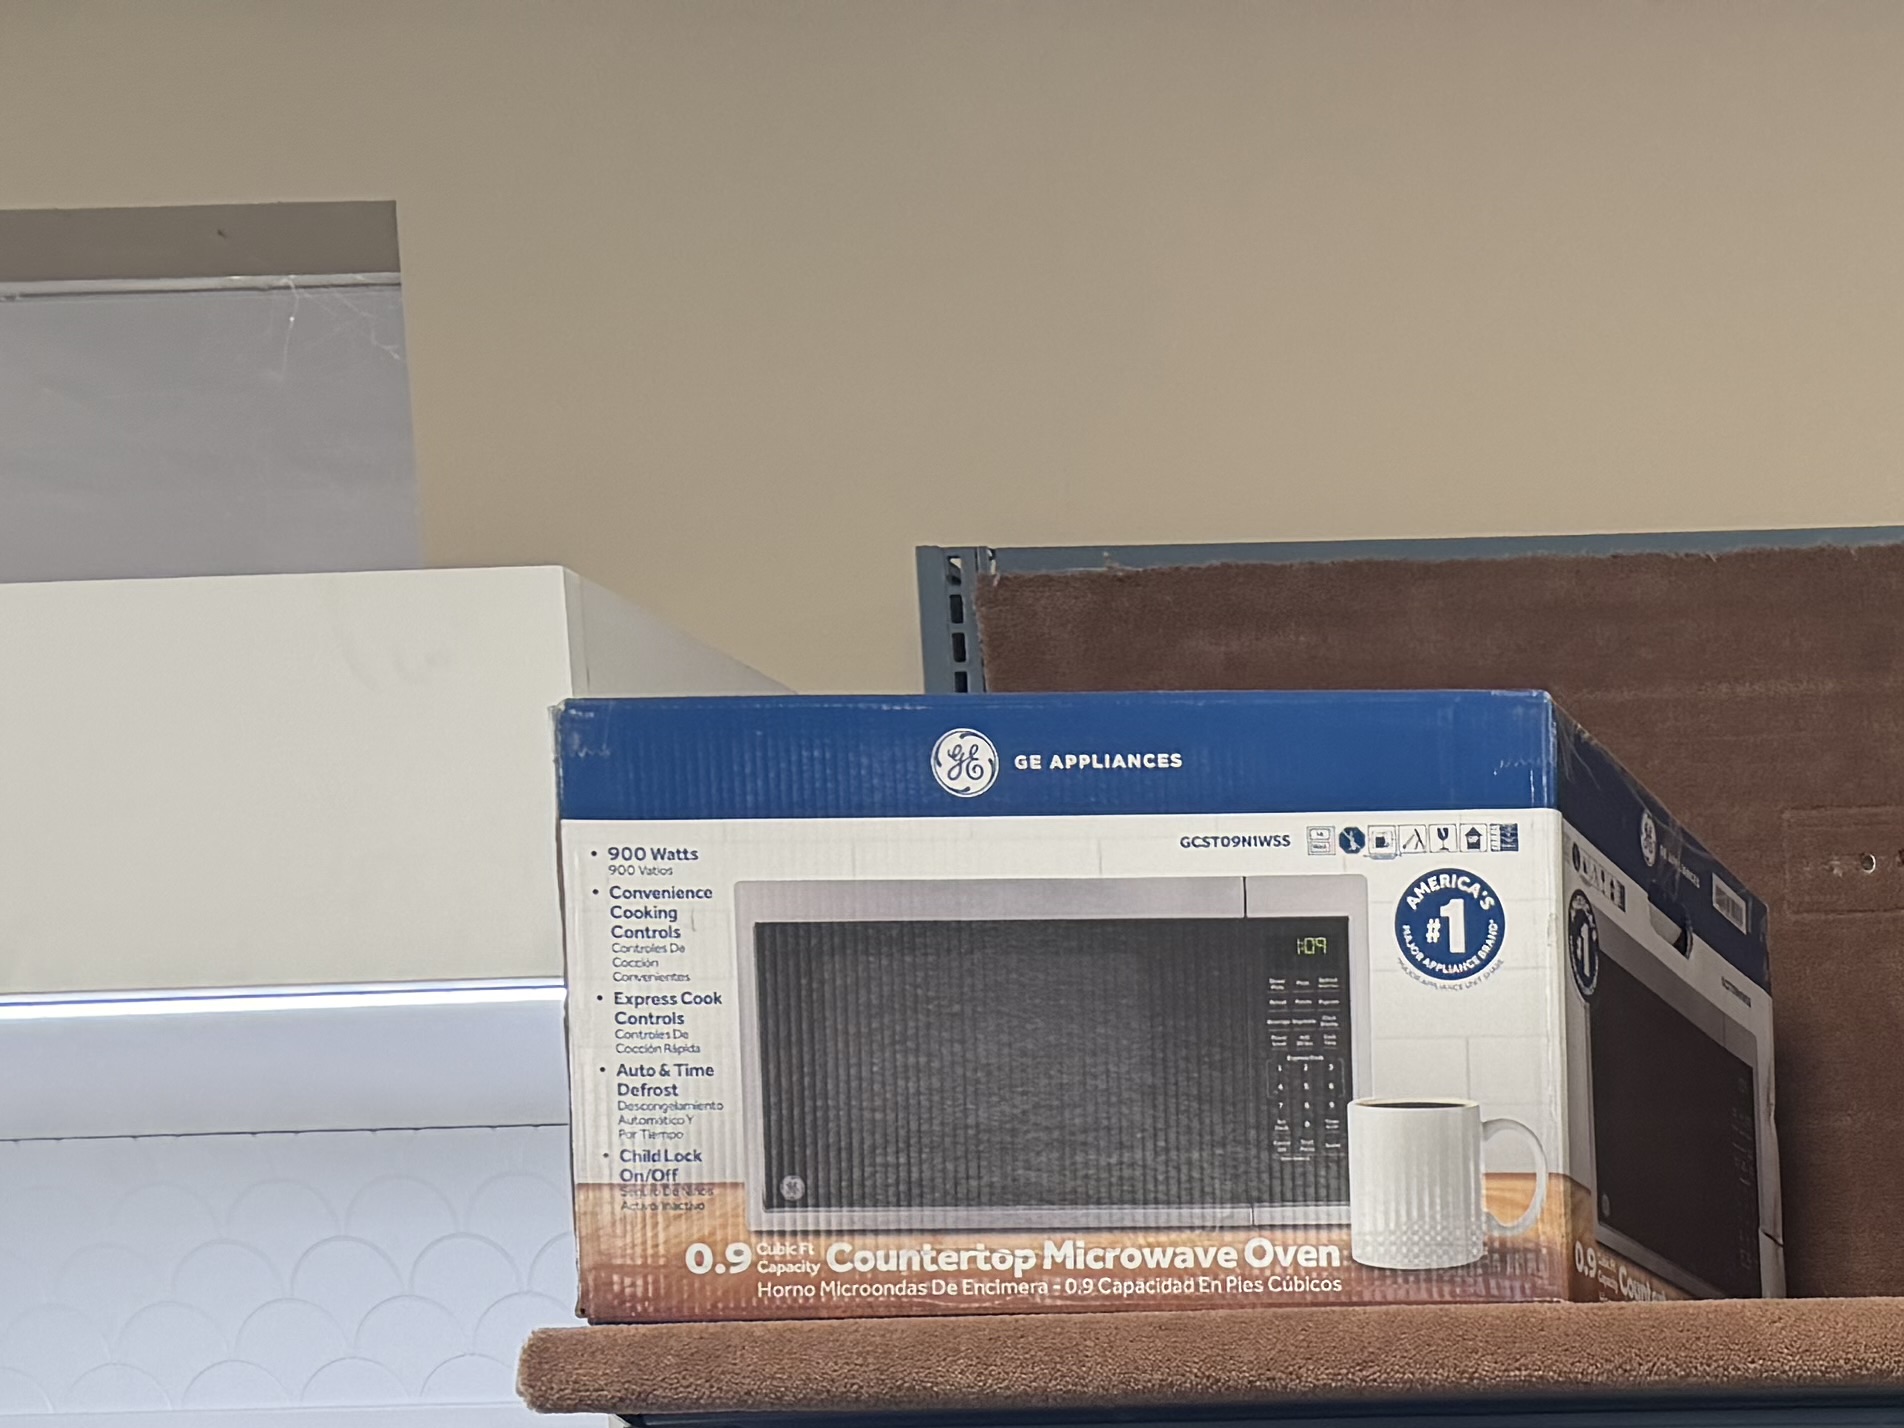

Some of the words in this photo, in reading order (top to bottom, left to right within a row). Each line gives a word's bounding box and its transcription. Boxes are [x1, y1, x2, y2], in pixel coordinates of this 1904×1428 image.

[1014, 755, 1041, 770] GE
[1050, 753, 1183, 769] APPLIANCES
[608, 847, 647, 861] 900
[650, 847, 699, 861] Watts
[609, 886, 713, 899] Convenience
[1404, 873, 1497, 914] AMERICA'S
[610, 906, 678, 922] Cooking
[611, 925, 681, 939] Controls
[685, 1242, 751, 1275] 0.9
[826, 1241, 1035, 1278] Countertop
[1043, 1240, 1238, 1271] Microwave
[1243, 1236, 1340, 1269] Oven
